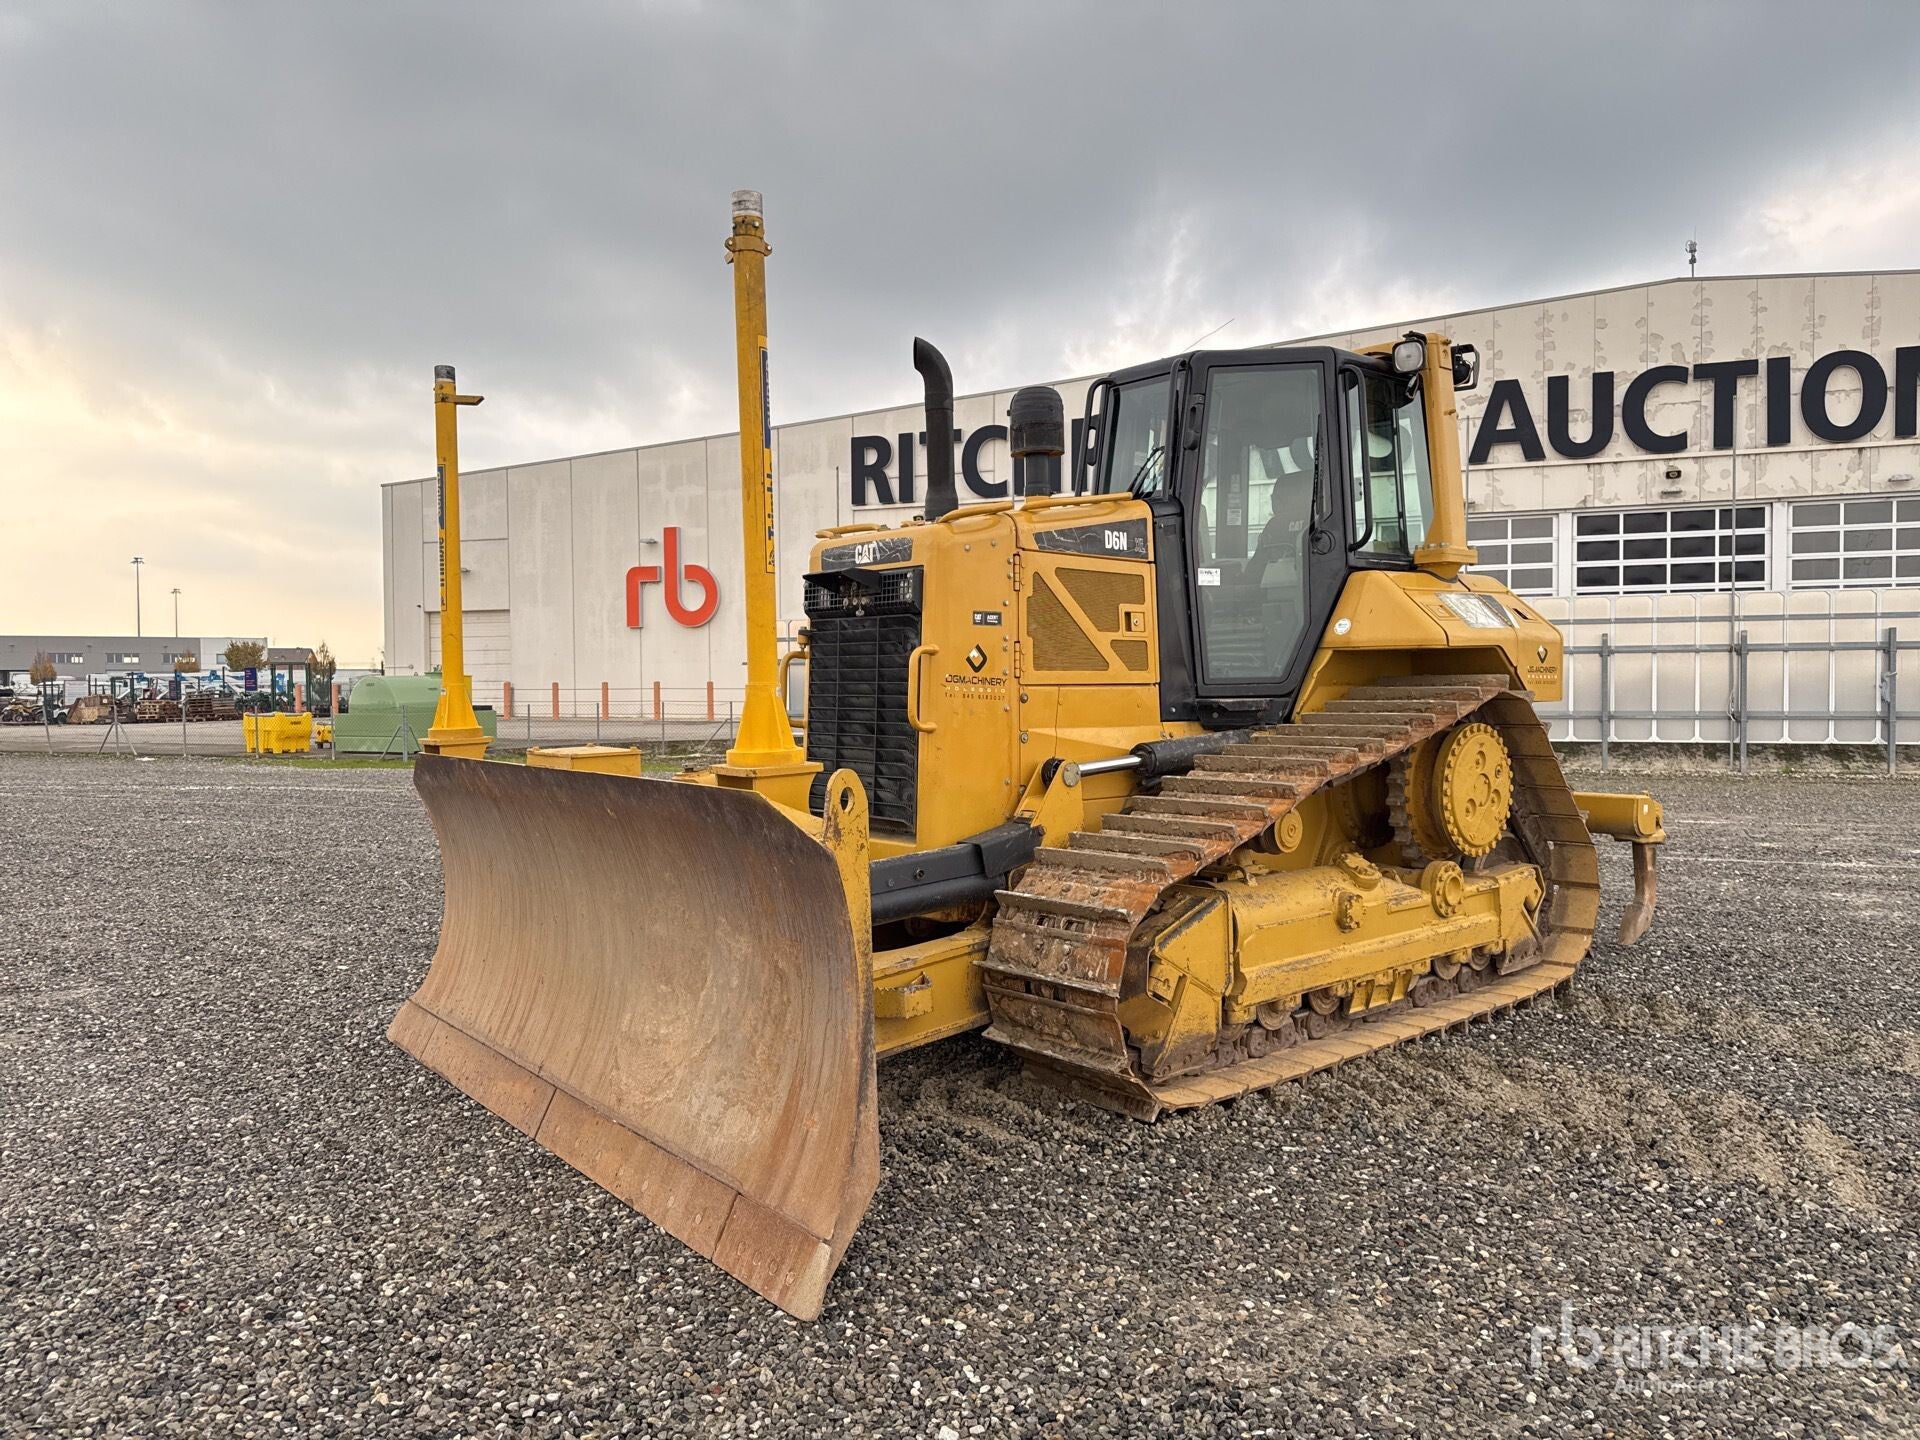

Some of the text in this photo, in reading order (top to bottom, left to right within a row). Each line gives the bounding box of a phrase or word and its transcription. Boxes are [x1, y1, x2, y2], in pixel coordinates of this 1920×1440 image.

[1104, 529, 1128, 551] D6N
[855, 541, 877, 565] CAT
[626, 526, 721, 629] rb
